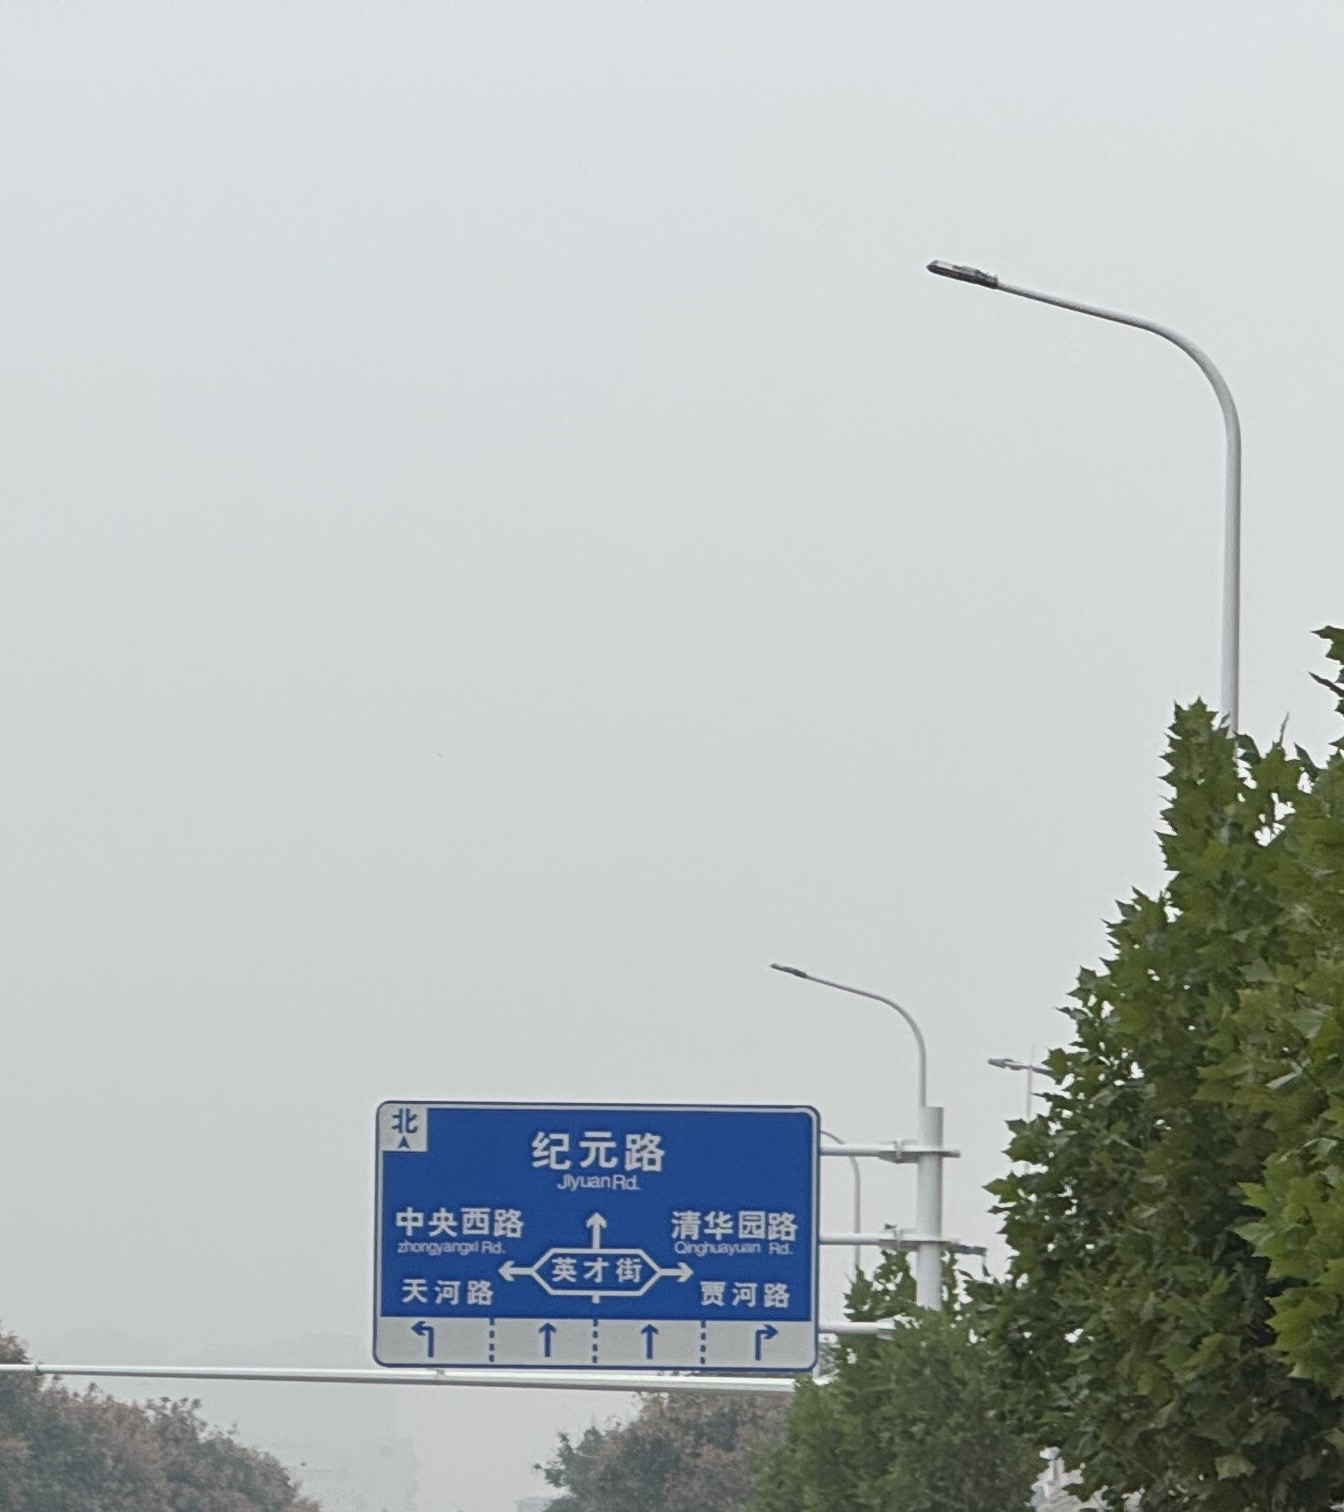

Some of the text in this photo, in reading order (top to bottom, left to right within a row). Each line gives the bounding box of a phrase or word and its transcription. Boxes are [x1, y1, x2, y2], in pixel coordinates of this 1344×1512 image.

[391, 1108, 418, 1134] 北
[531, 1131, 665, 1172] 纪元路
[395, 1206, 525, 1238] 中央西路
[671, 1210, 798, 1241] 清华园路
[481, 1241, 505, 1254] Rd.
[768, 1241, 794, 1255] Rd.
[551, 1257, 642, 1284] 英才街
[401, 1278, 494, 1306] 天河路
[700, 1281, 790, 1308] 贾河路
